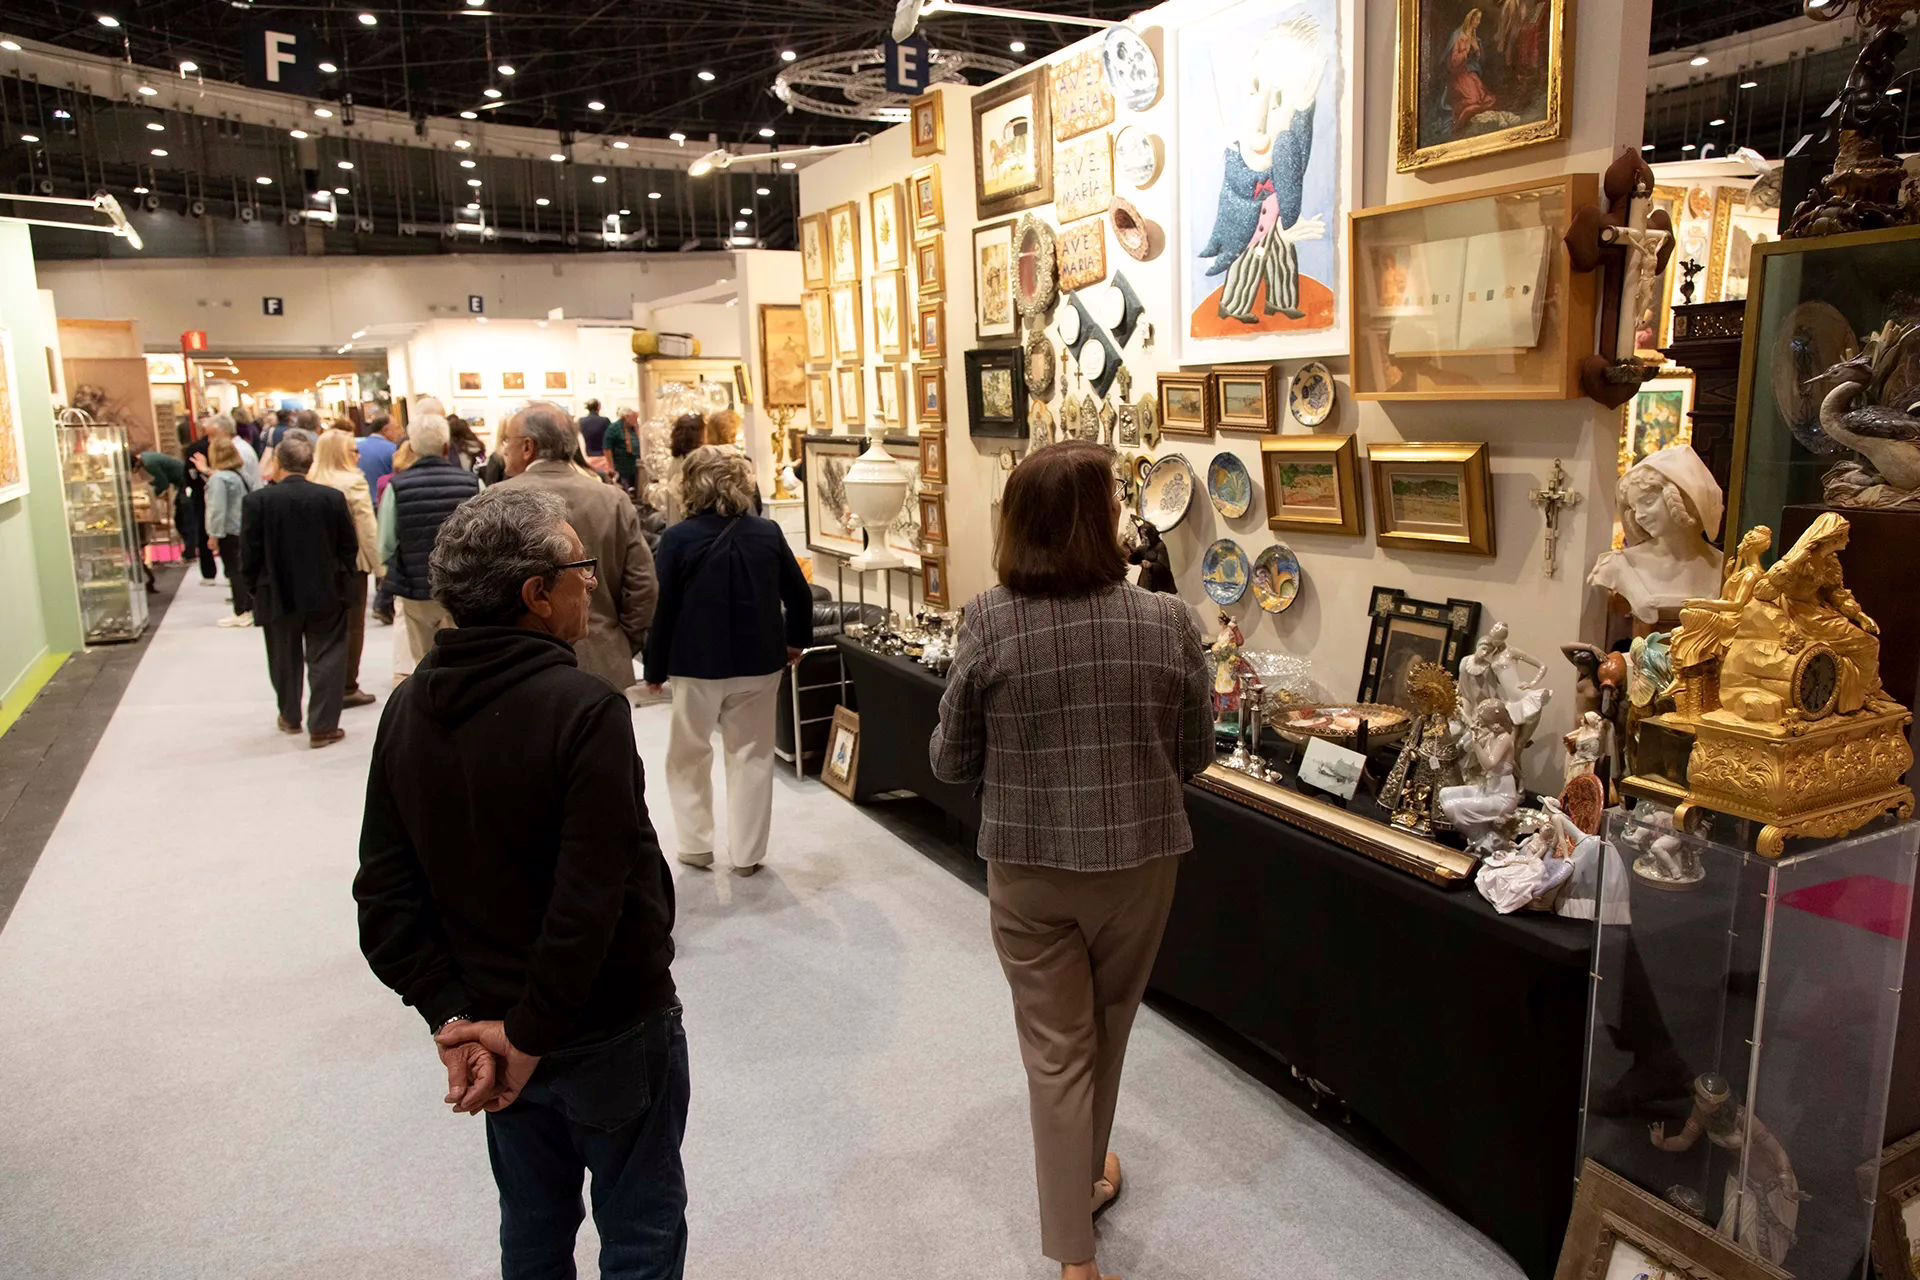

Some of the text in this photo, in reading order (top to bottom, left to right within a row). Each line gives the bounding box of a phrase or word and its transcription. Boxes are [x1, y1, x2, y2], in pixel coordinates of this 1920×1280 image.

[265, 30, 296, 82] F
[897, 45, 918, 87] E
[1062, 234, 1089, 256] AVE
[1063, 256, 1095, 275] MARIA
[268, 299, 279, 314] F
[471, 297, 481, 311] E
